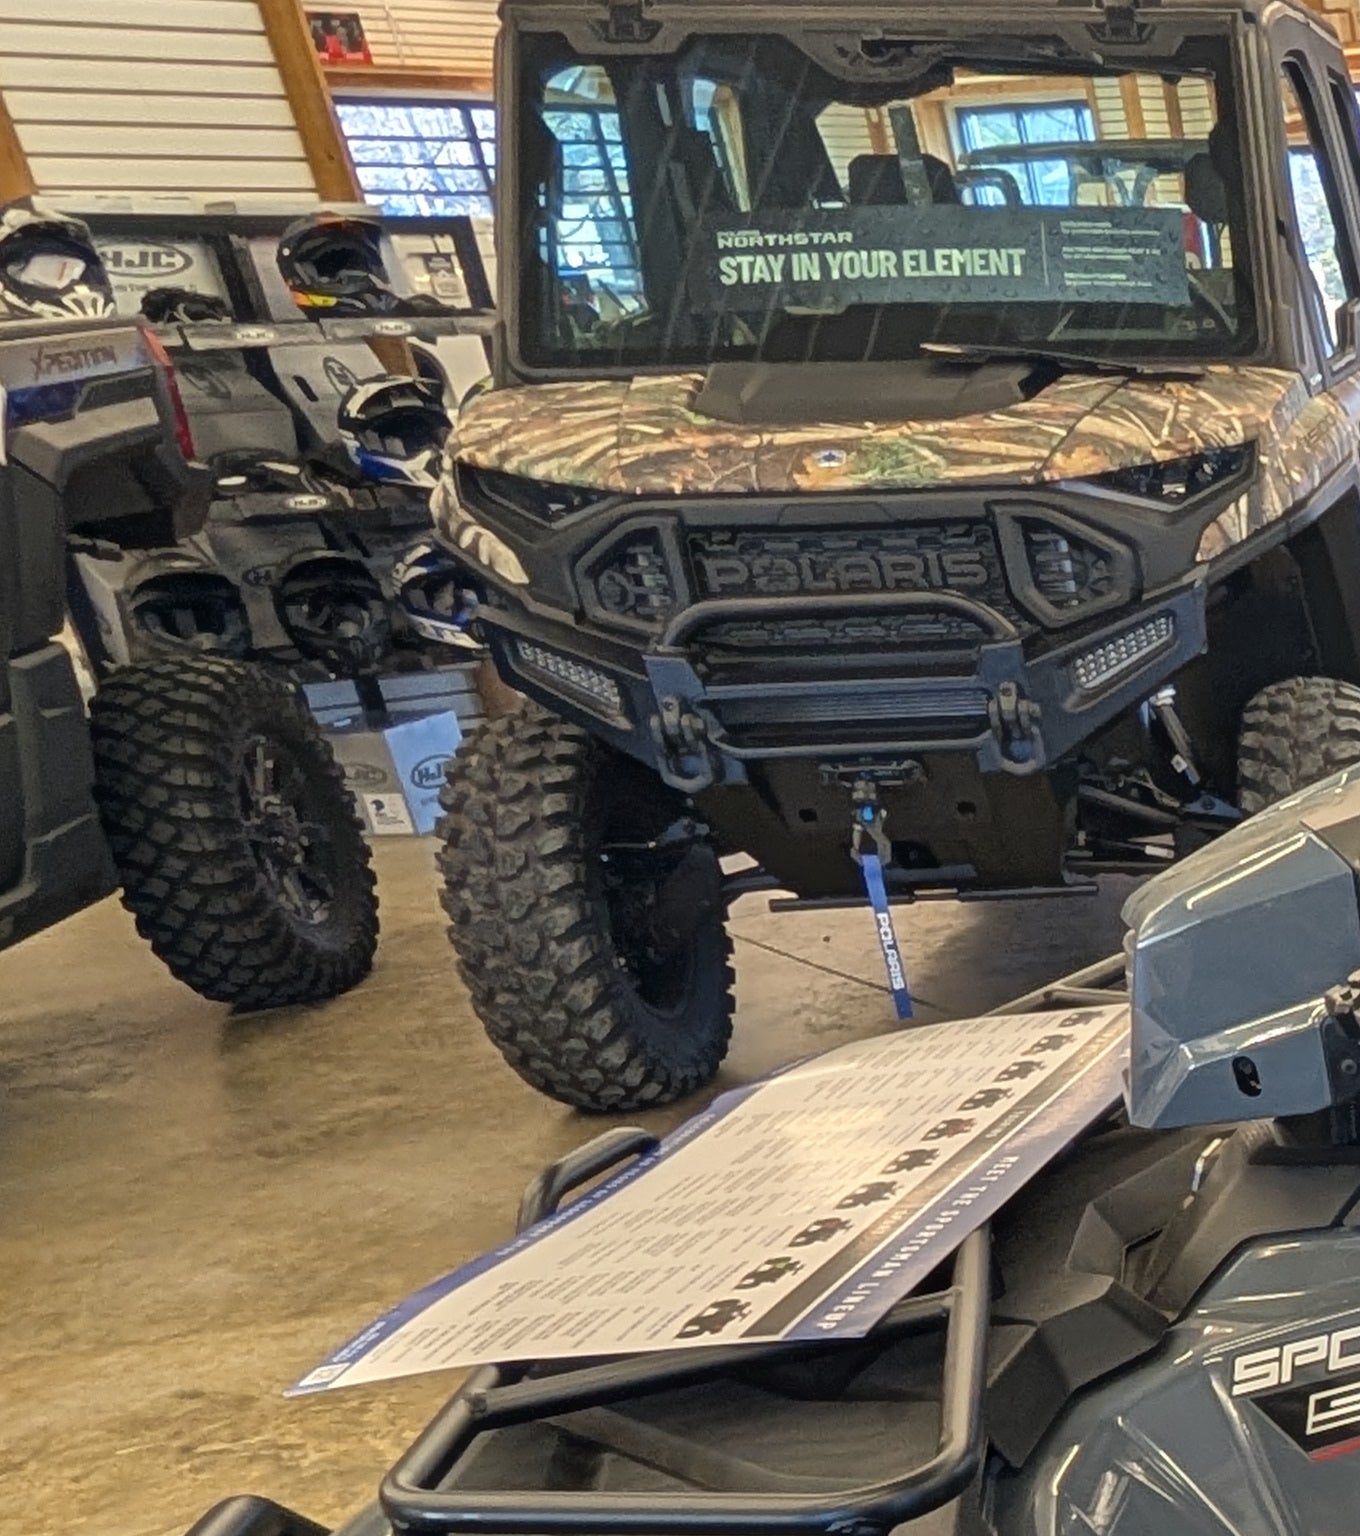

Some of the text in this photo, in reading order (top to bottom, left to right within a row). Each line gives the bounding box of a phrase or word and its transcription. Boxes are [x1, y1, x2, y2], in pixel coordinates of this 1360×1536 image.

[104, 250, 178, 269] HJC
[718, 231, 853, 249] NORTHSTAR
[718, 248, 1027, 286] STAY IN YOUR ELEMENT
[704, 551, 988, 592] POLARIS
[876, 912, 905, 991] POLARIS
[815, 1155, 1020, 1331] MEET THE SPORTSMAN LINEUP
